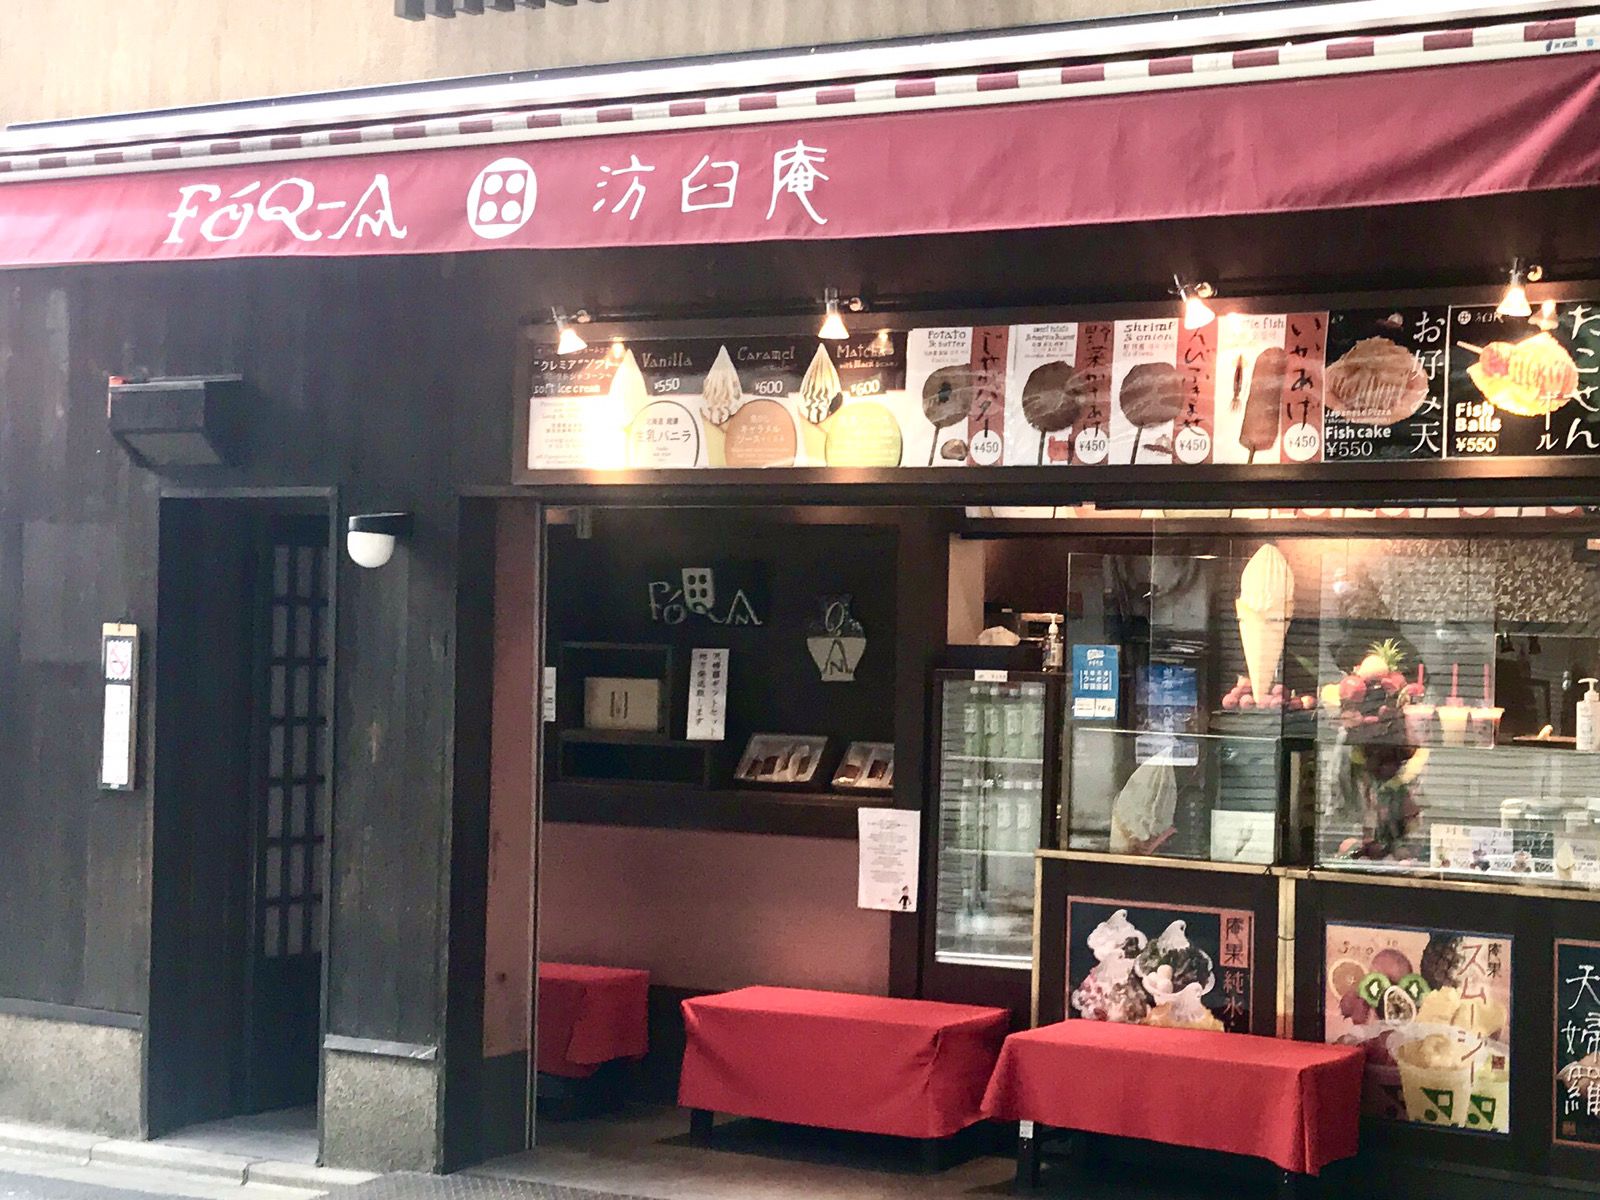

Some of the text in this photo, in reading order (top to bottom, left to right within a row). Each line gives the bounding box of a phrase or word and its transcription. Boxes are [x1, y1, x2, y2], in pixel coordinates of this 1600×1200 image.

[641, 351, 693, 369] Vanilla
[737, 346, 796, 361] Caramel
[754, 380, 784, 394] ¥600
[1455, 401, 1494, 418] Fish
[1325, 424, 1392, 440] Fish cake
[1455, 417, 1502, 433] Balls
[973, 440, 999, 453] ¥450
[1079, 439, 1106, 452] ¥450
[1179, 438, 1207, 452] ¥450
[1289, 435, 1317, 449] ¥450
[1326, 440, 1374, 457] ¥550
[1455, 437, 1498, 453] ¥550
